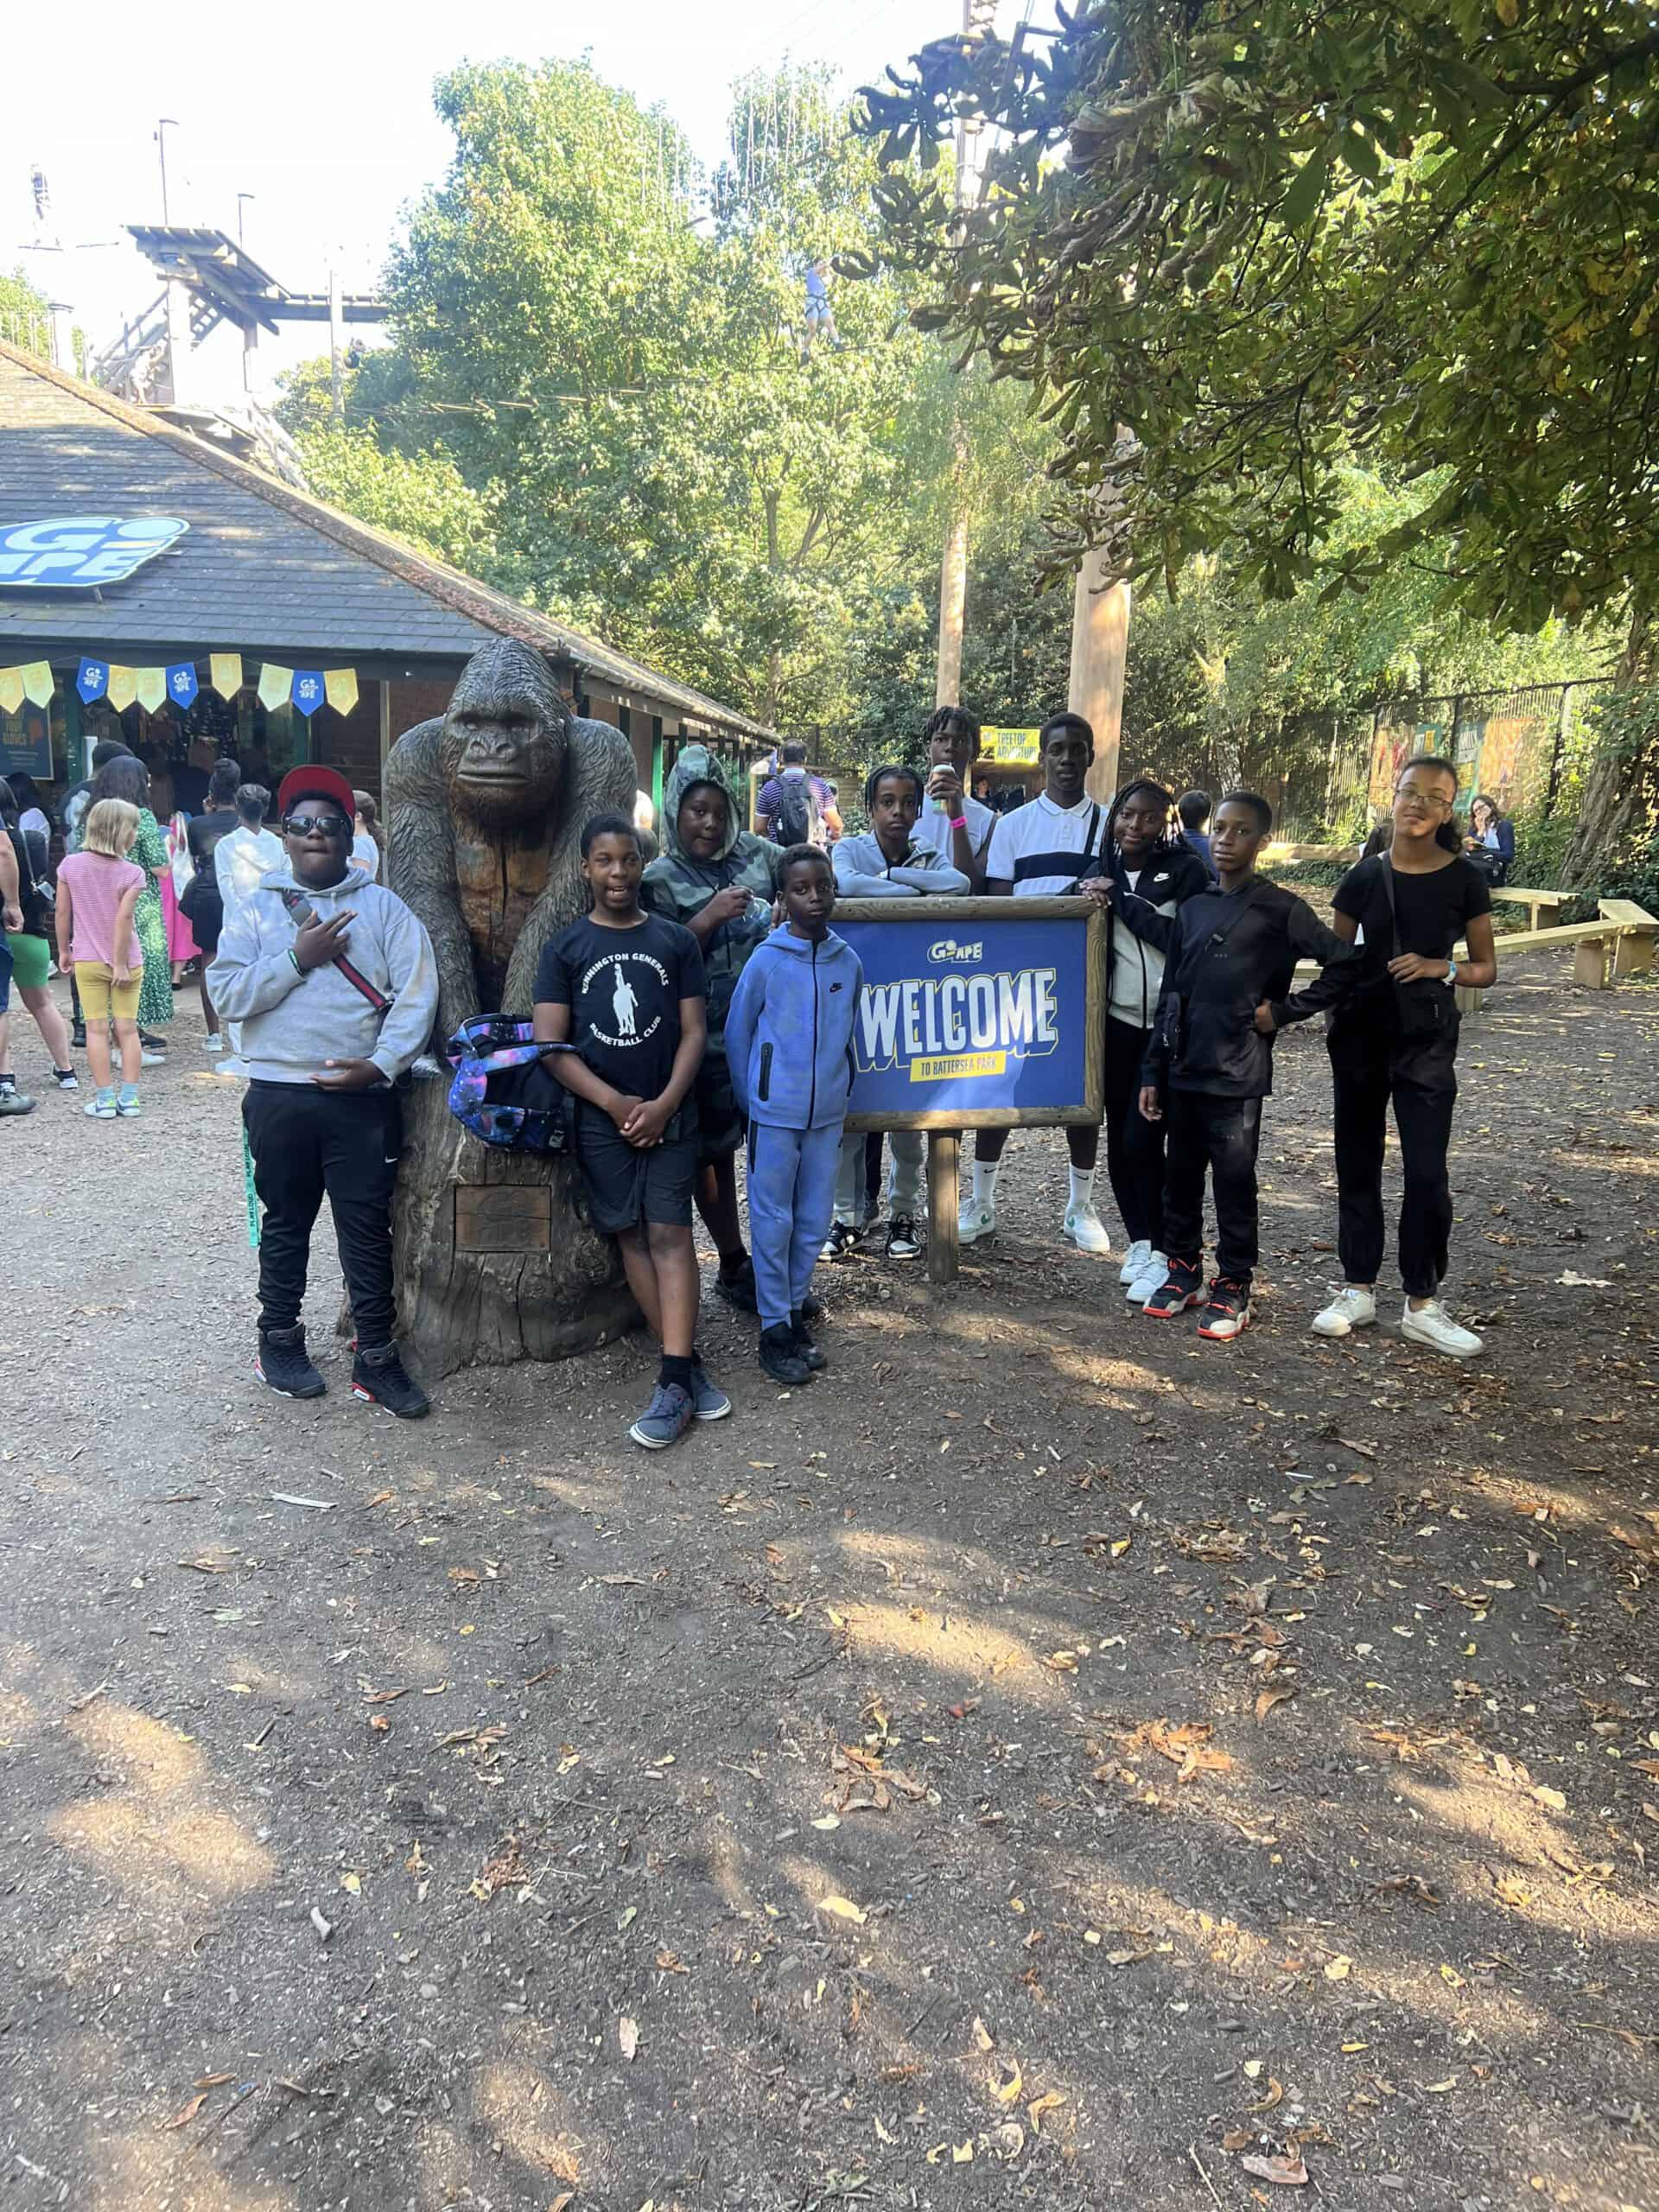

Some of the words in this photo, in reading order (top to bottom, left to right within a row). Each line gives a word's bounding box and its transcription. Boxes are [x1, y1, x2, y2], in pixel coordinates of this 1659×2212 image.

[4, 516, 183, 550] GO
[632, 952, 669, 987] GENERALS
[589, 1022, 644, 1046] BASKETBALL
[643, 1015, 662, 1038] CLUB
[859, 970, 1056, 1059] WELCOME
[921, 1062, 931, 1076] TO
[933, 1058, 975, 1075] BATTERSEA
[976, 1057, 996, 1071] PARK
